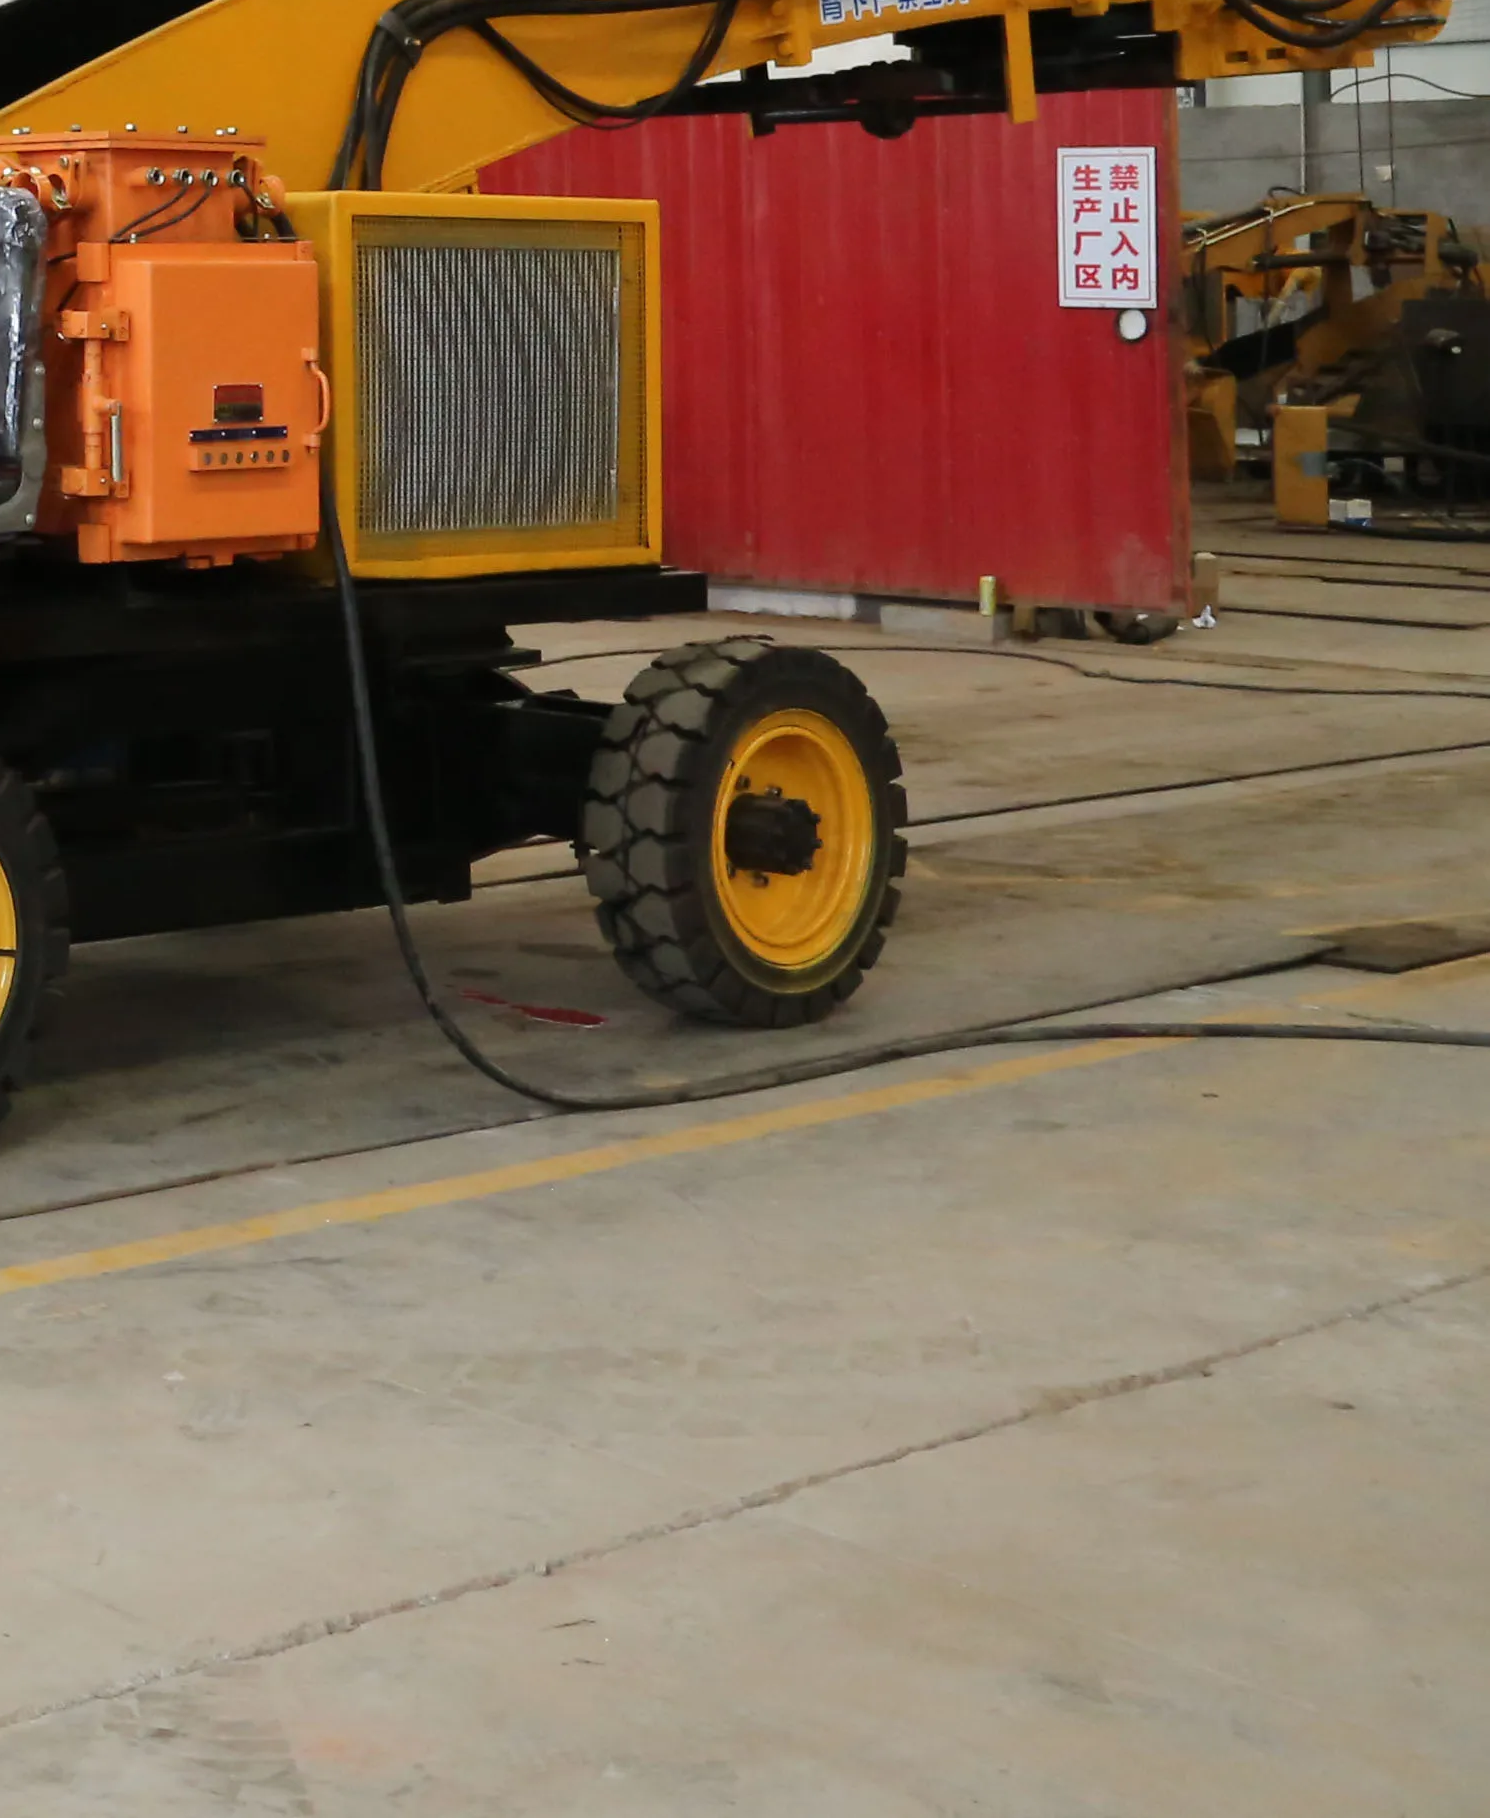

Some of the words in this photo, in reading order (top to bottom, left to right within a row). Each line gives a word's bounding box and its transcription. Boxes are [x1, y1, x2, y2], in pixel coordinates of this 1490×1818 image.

[1073, 164, 1102, 289] 生产厂区
[1109, 164, 1139, 290] 禁止入内
